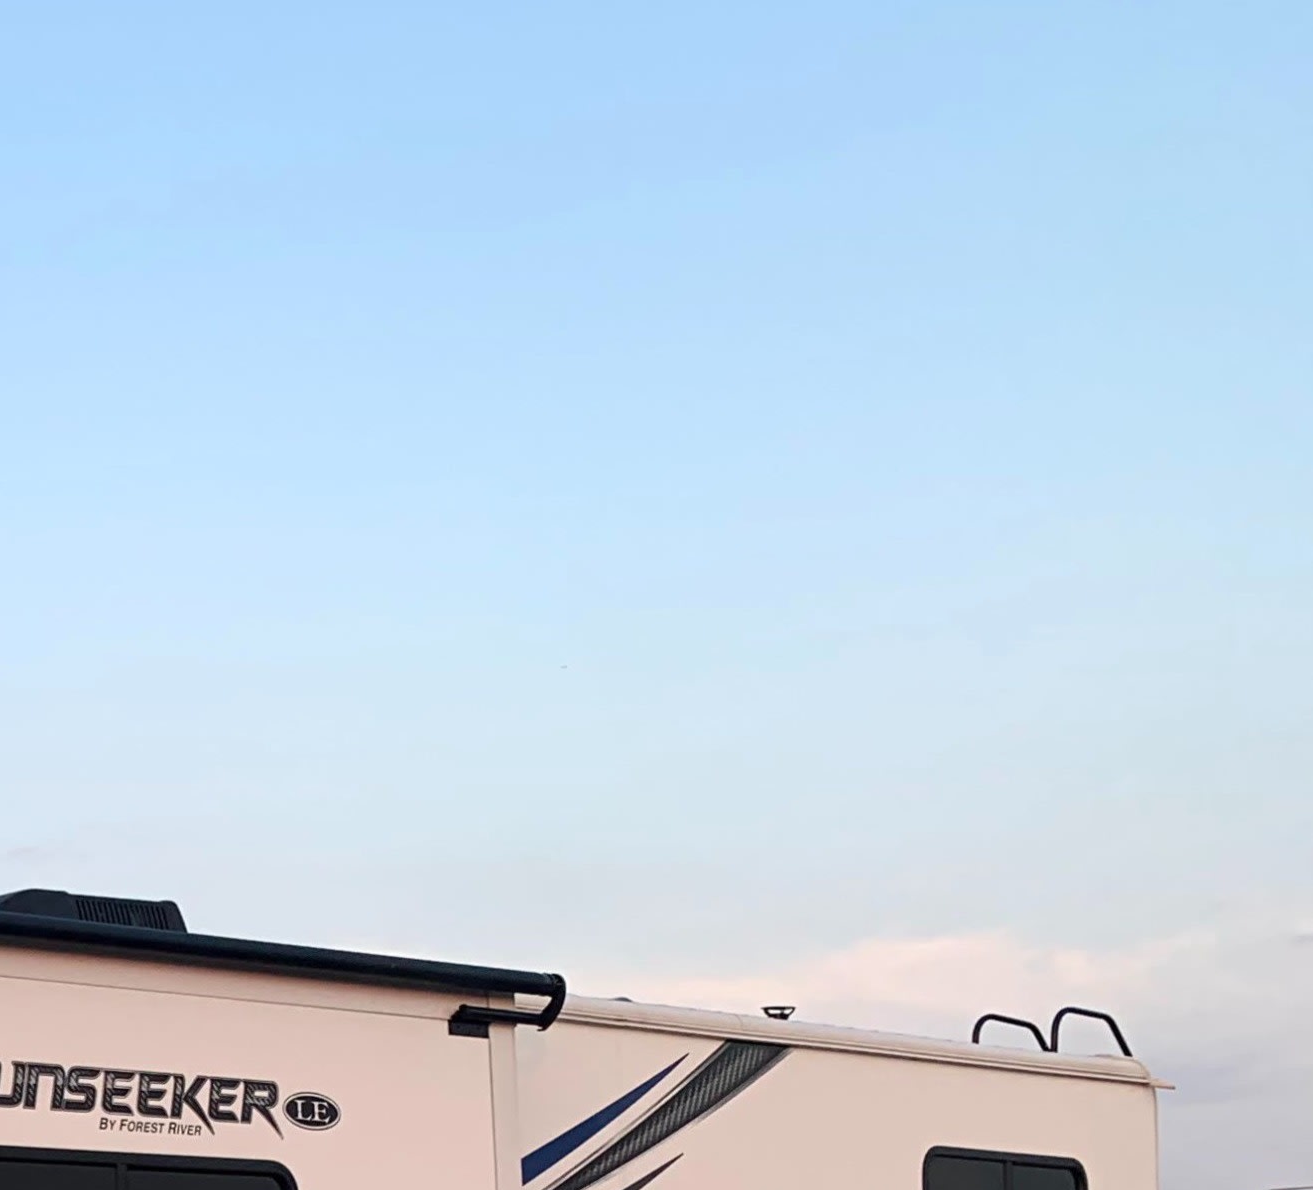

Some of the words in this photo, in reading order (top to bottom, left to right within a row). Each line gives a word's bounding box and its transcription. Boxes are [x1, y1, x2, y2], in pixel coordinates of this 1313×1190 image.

[294, 1099, 331, 1124] LE
[119, 1118, 165, 1134] FOREST
[168, 1122, 202, 1136] RIVER
